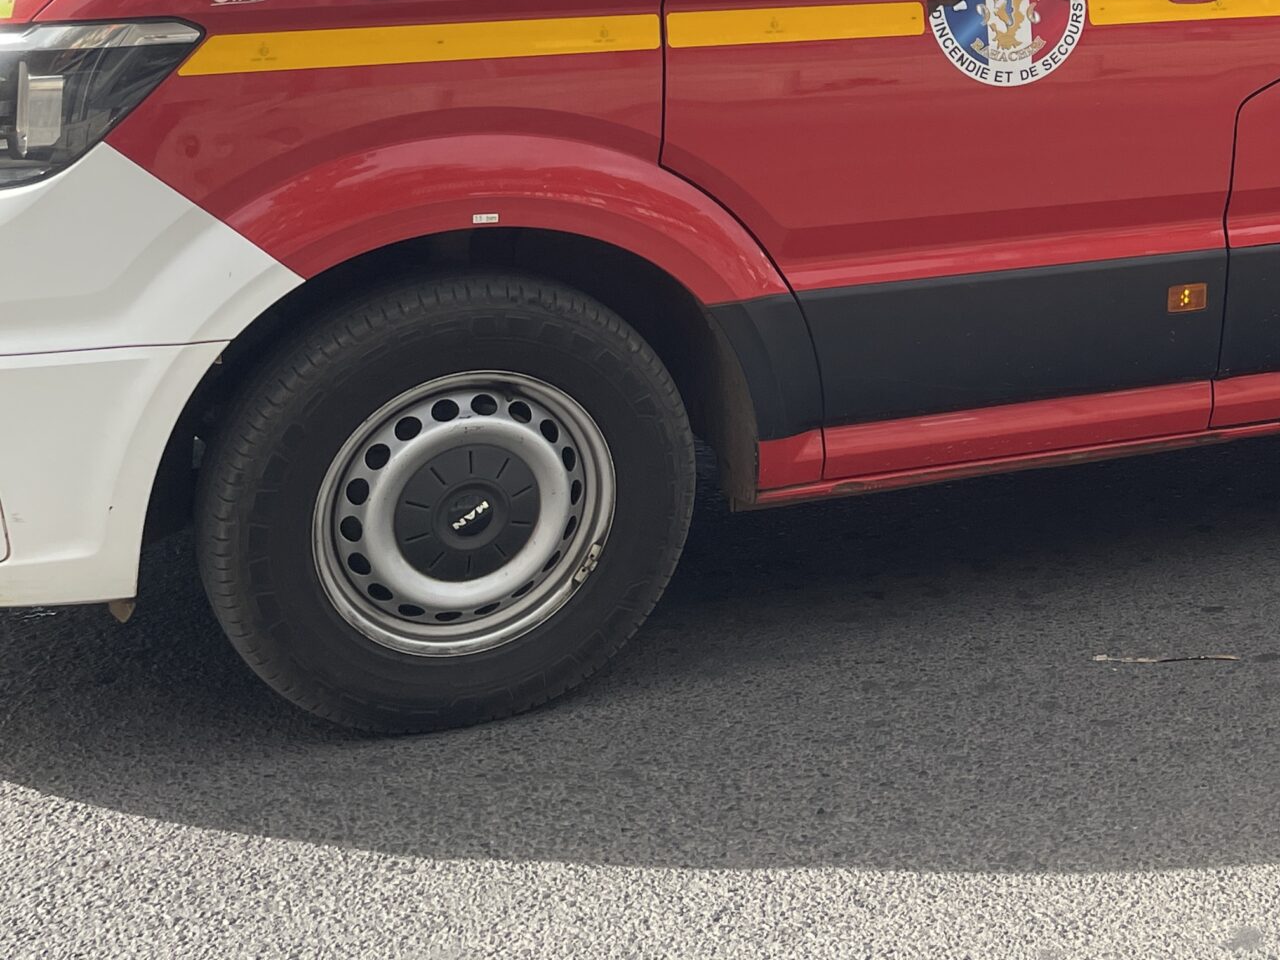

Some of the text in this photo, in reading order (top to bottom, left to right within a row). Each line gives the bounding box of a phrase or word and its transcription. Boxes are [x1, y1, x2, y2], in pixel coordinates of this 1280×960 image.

[994, 70, 1014, 83] ET
[1020, 65, 1040, 81] DE
[1041, 2, 1084, 72] SECOURS
[452, 500, 489, 530] MAN
